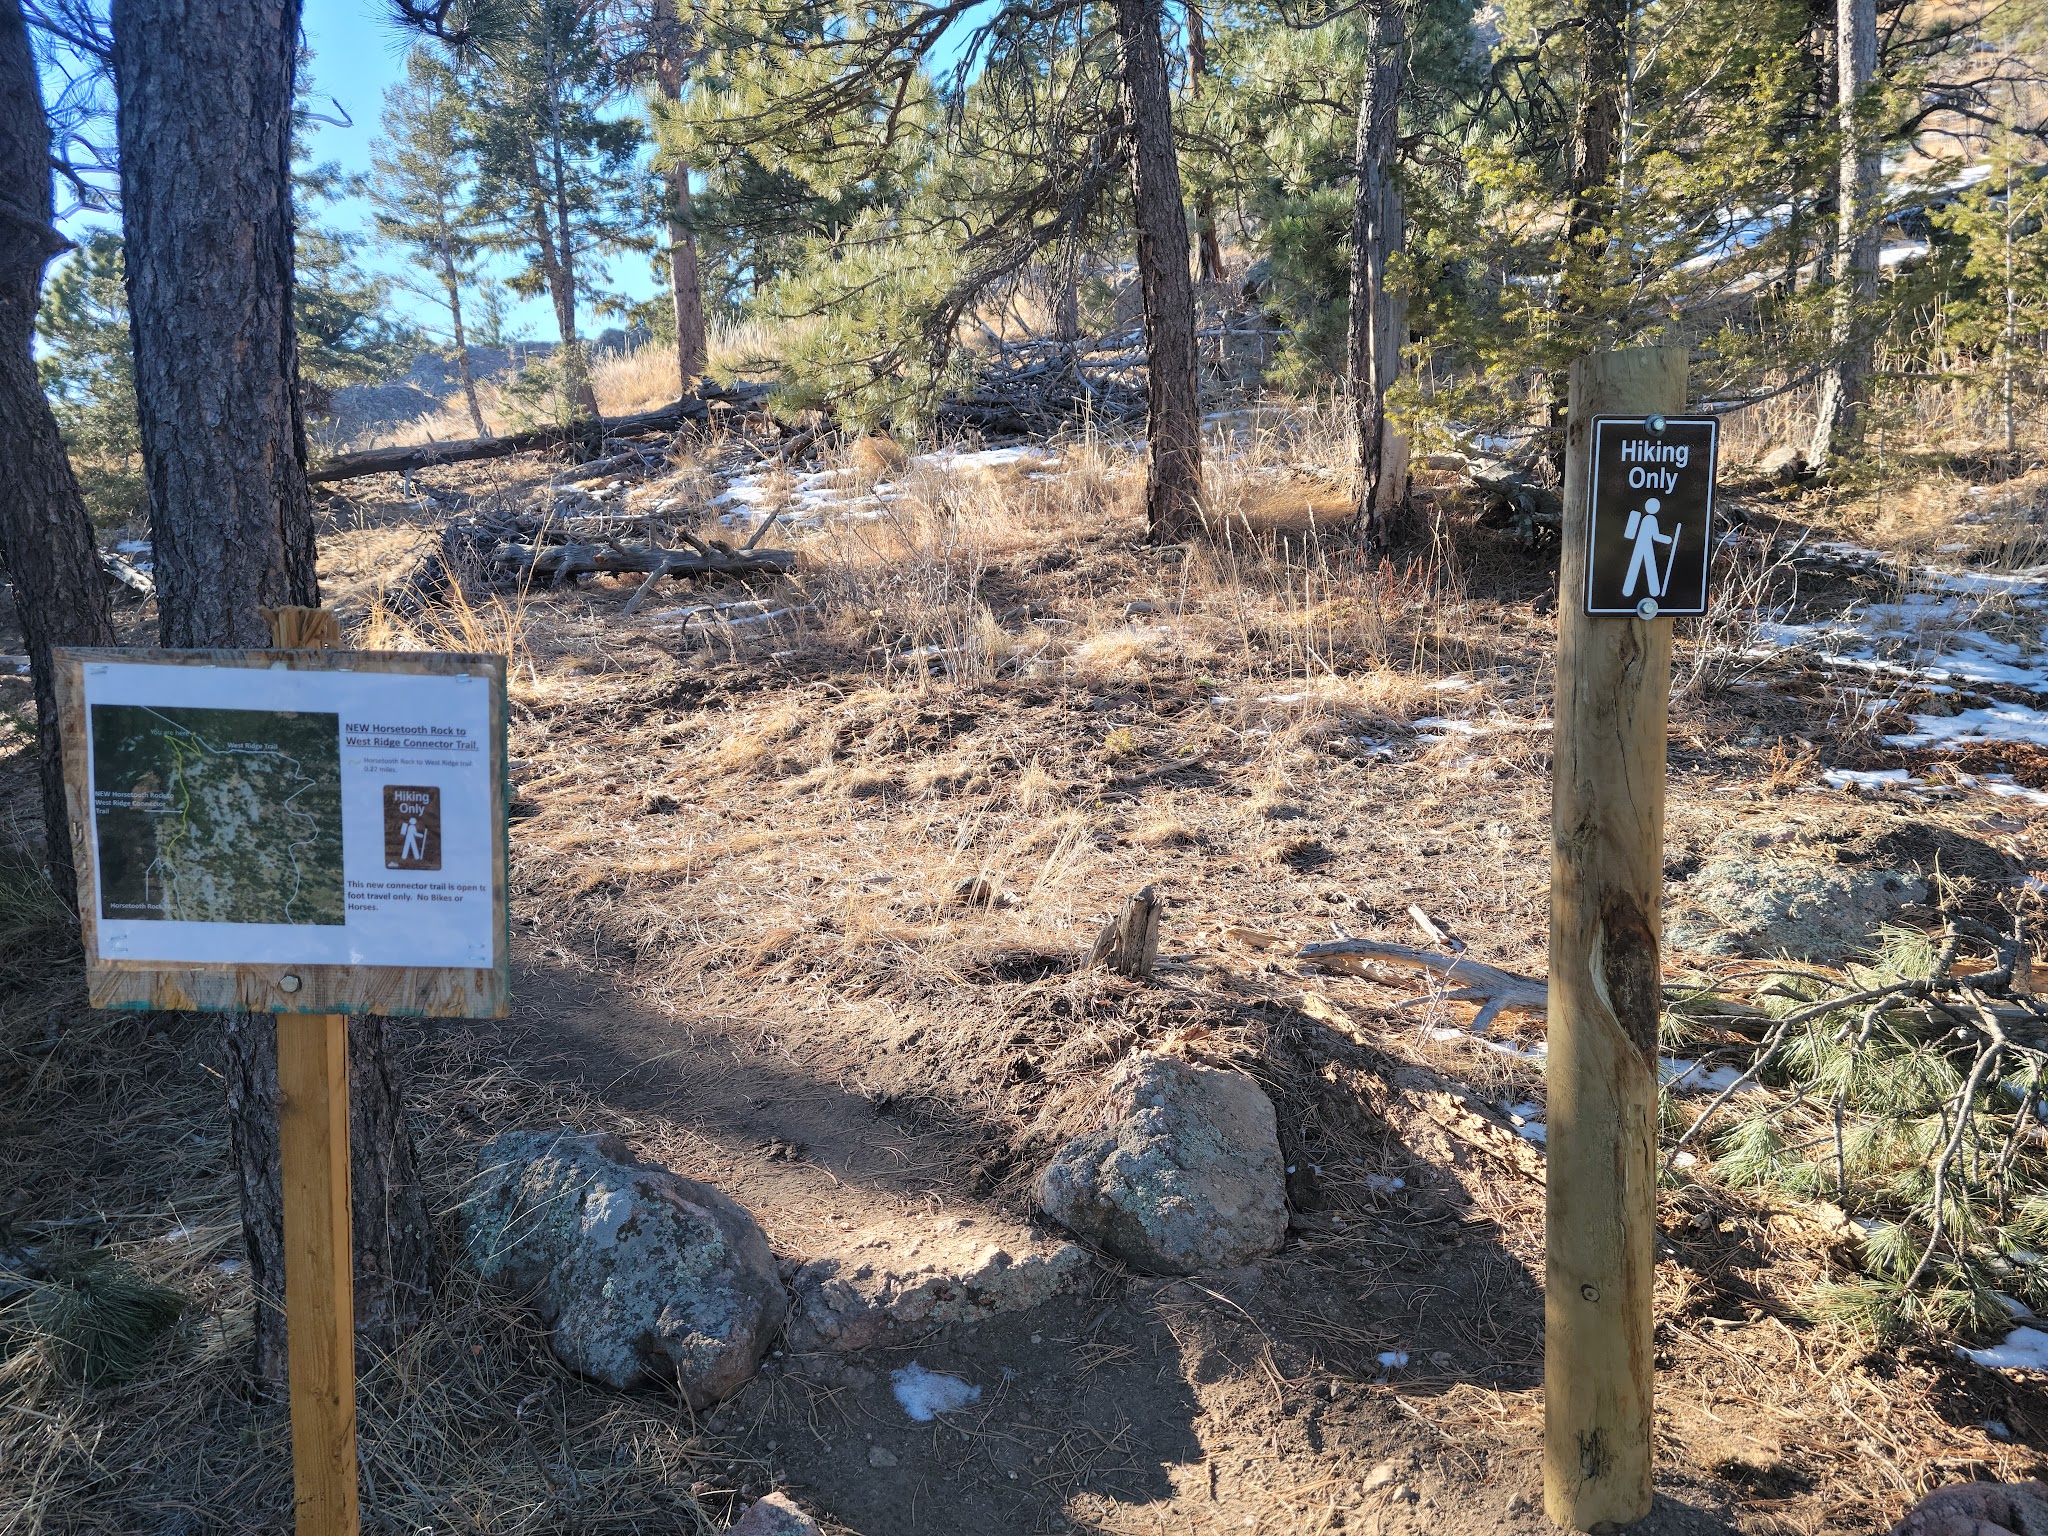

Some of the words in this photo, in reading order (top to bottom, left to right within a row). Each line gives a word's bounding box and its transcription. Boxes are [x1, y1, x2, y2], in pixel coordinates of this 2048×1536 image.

[1621, 440, 1689, 468] Hiking
[1629, 467, 1678, 494] Only
[345, 724, 369, 732] NEW
[373, 724, 427, 734] Horsetooth
[431, 726, 452, 735] Rock
[346, 737, 370, 746] West
[374, 738, 400, 748] Ridge
[404, 739, 452, 748] Connector
[456, 740, 478, 750] Trail.
[394, 791, 429, 804] Hiking
[400, 803, 425, 816] Only
[430, 882, 446, 890] trail
[348, 892, 364, 900] foot
[367, 892, 390, 900] travel
[393, 893, 412, 902] only.
[431, 894, 452, 902] Bikes
